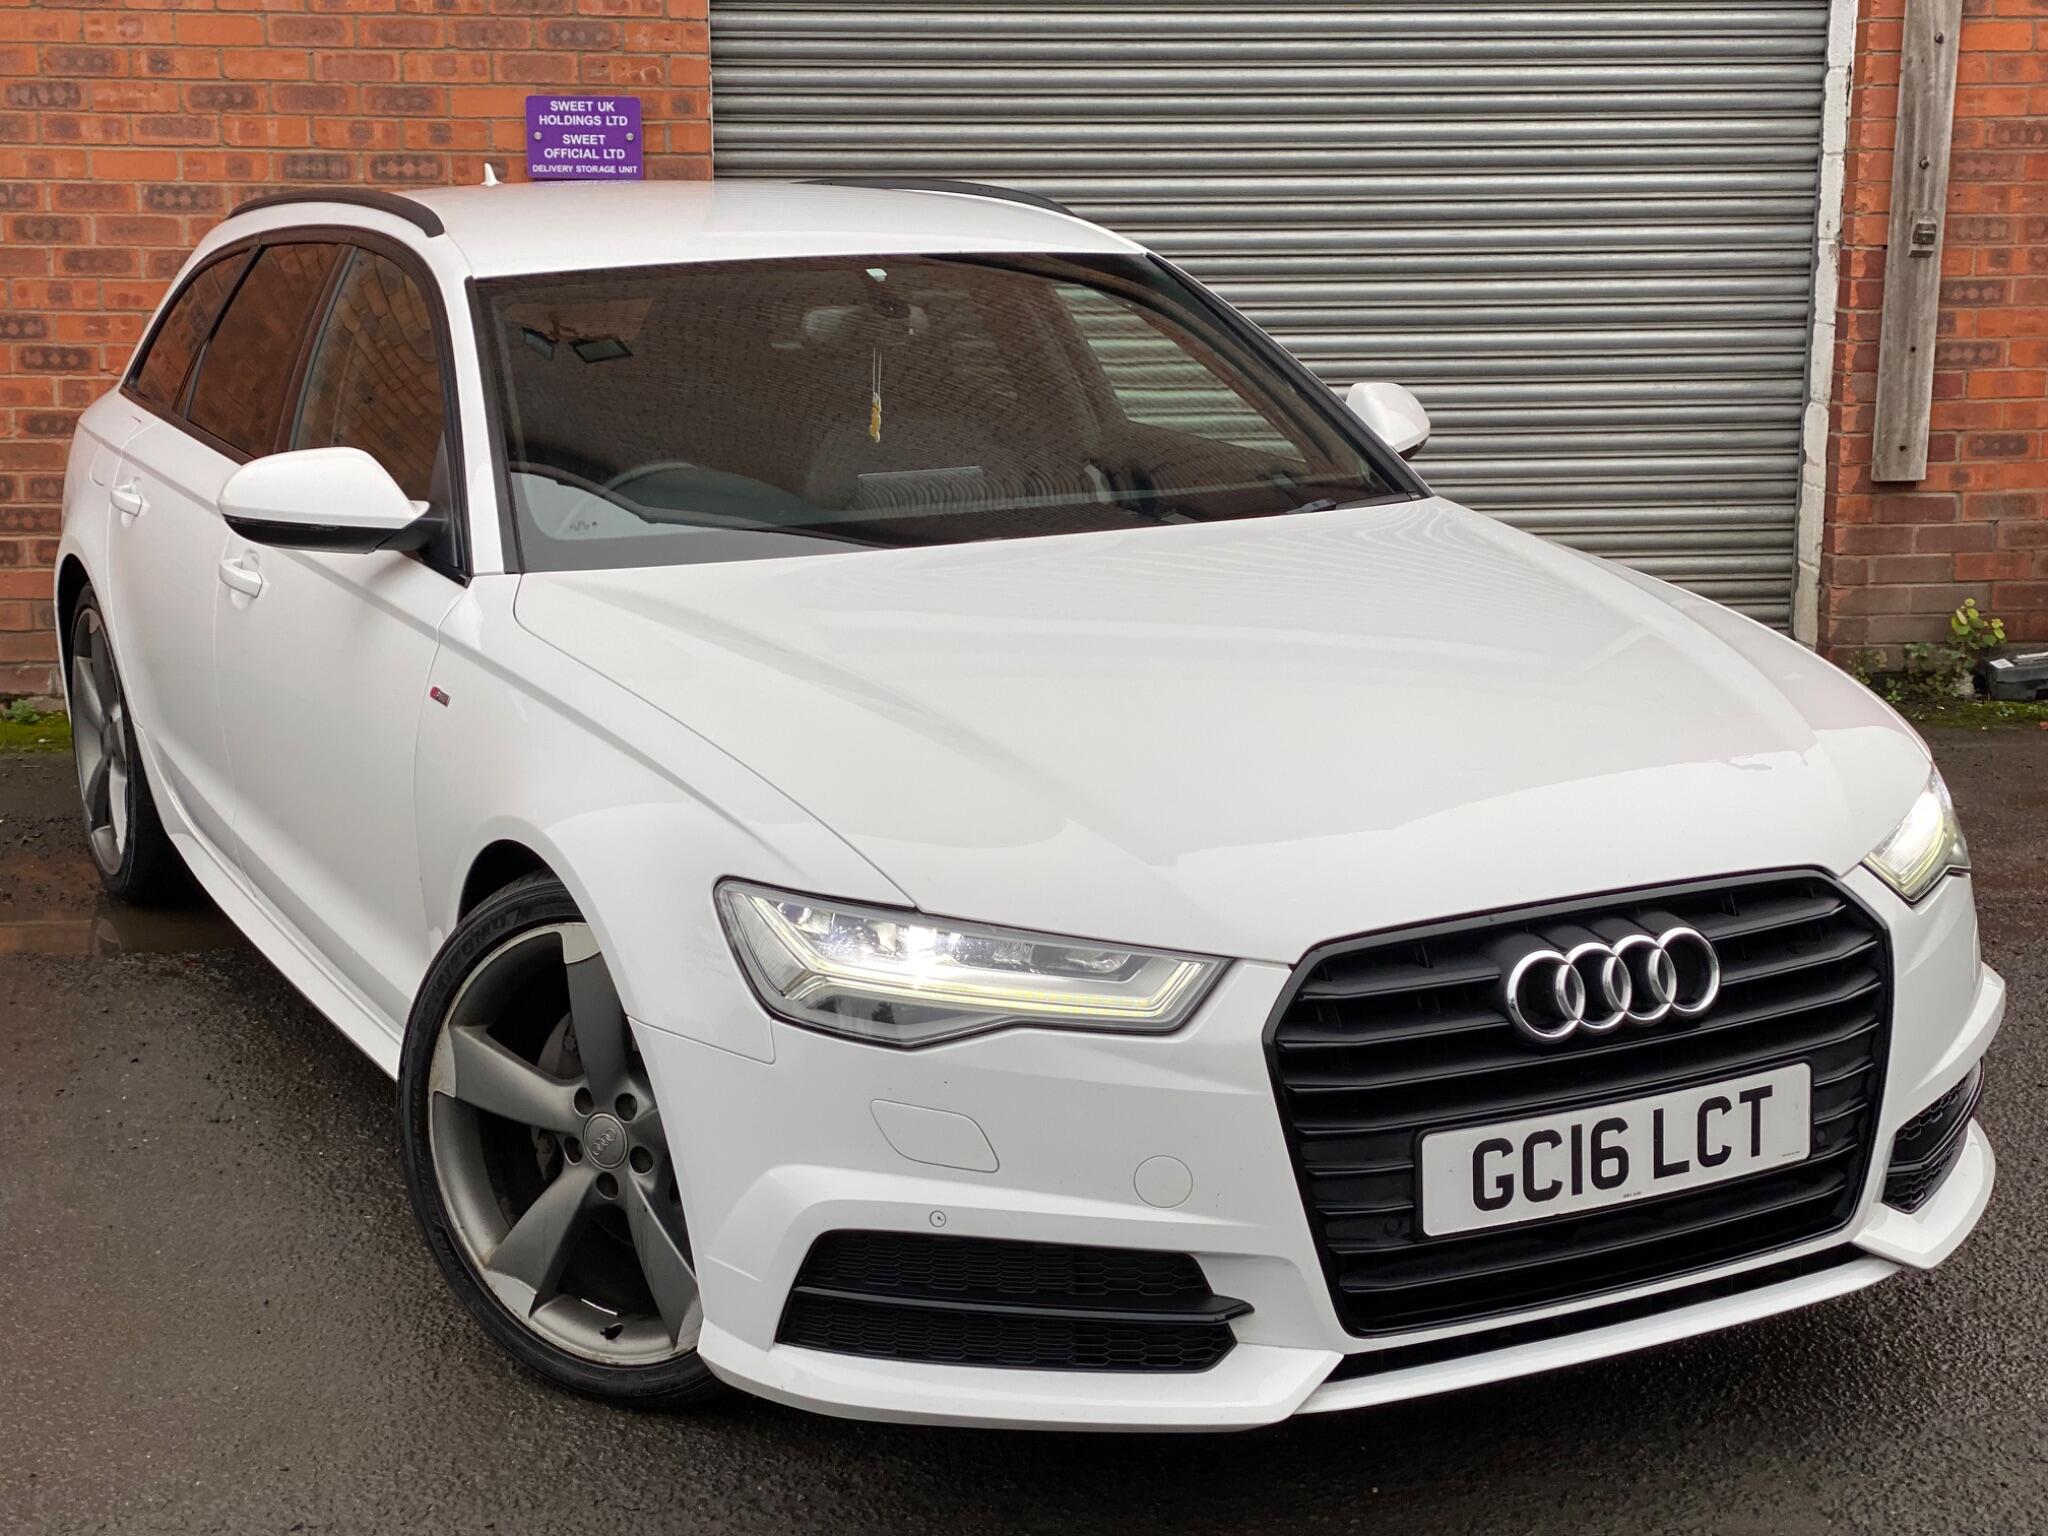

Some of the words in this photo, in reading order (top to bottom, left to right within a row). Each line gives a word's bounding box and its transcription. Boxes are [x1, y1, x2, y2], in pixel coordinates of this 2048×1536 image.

[550, 100, 593, 112] SWEET
[598, 101, 615, 112] UK
[539, 114, 601, 125] HOLDINGS
[606, 115, 628, 126] LTD
[562, 134, 606, 145] SWEET
[544, 148, 599, 159] OFFICIAL
[603, 148, 625, 159] LTD
[532, 165, 573, 173] DELIVERY
[576, 165, 616, 174] STORAGE
[619, 166, 638, 174] UNIT
[1472, 1116, 1630, 1212] GC16
[1653, 1085, 1773, 1180] LCT
